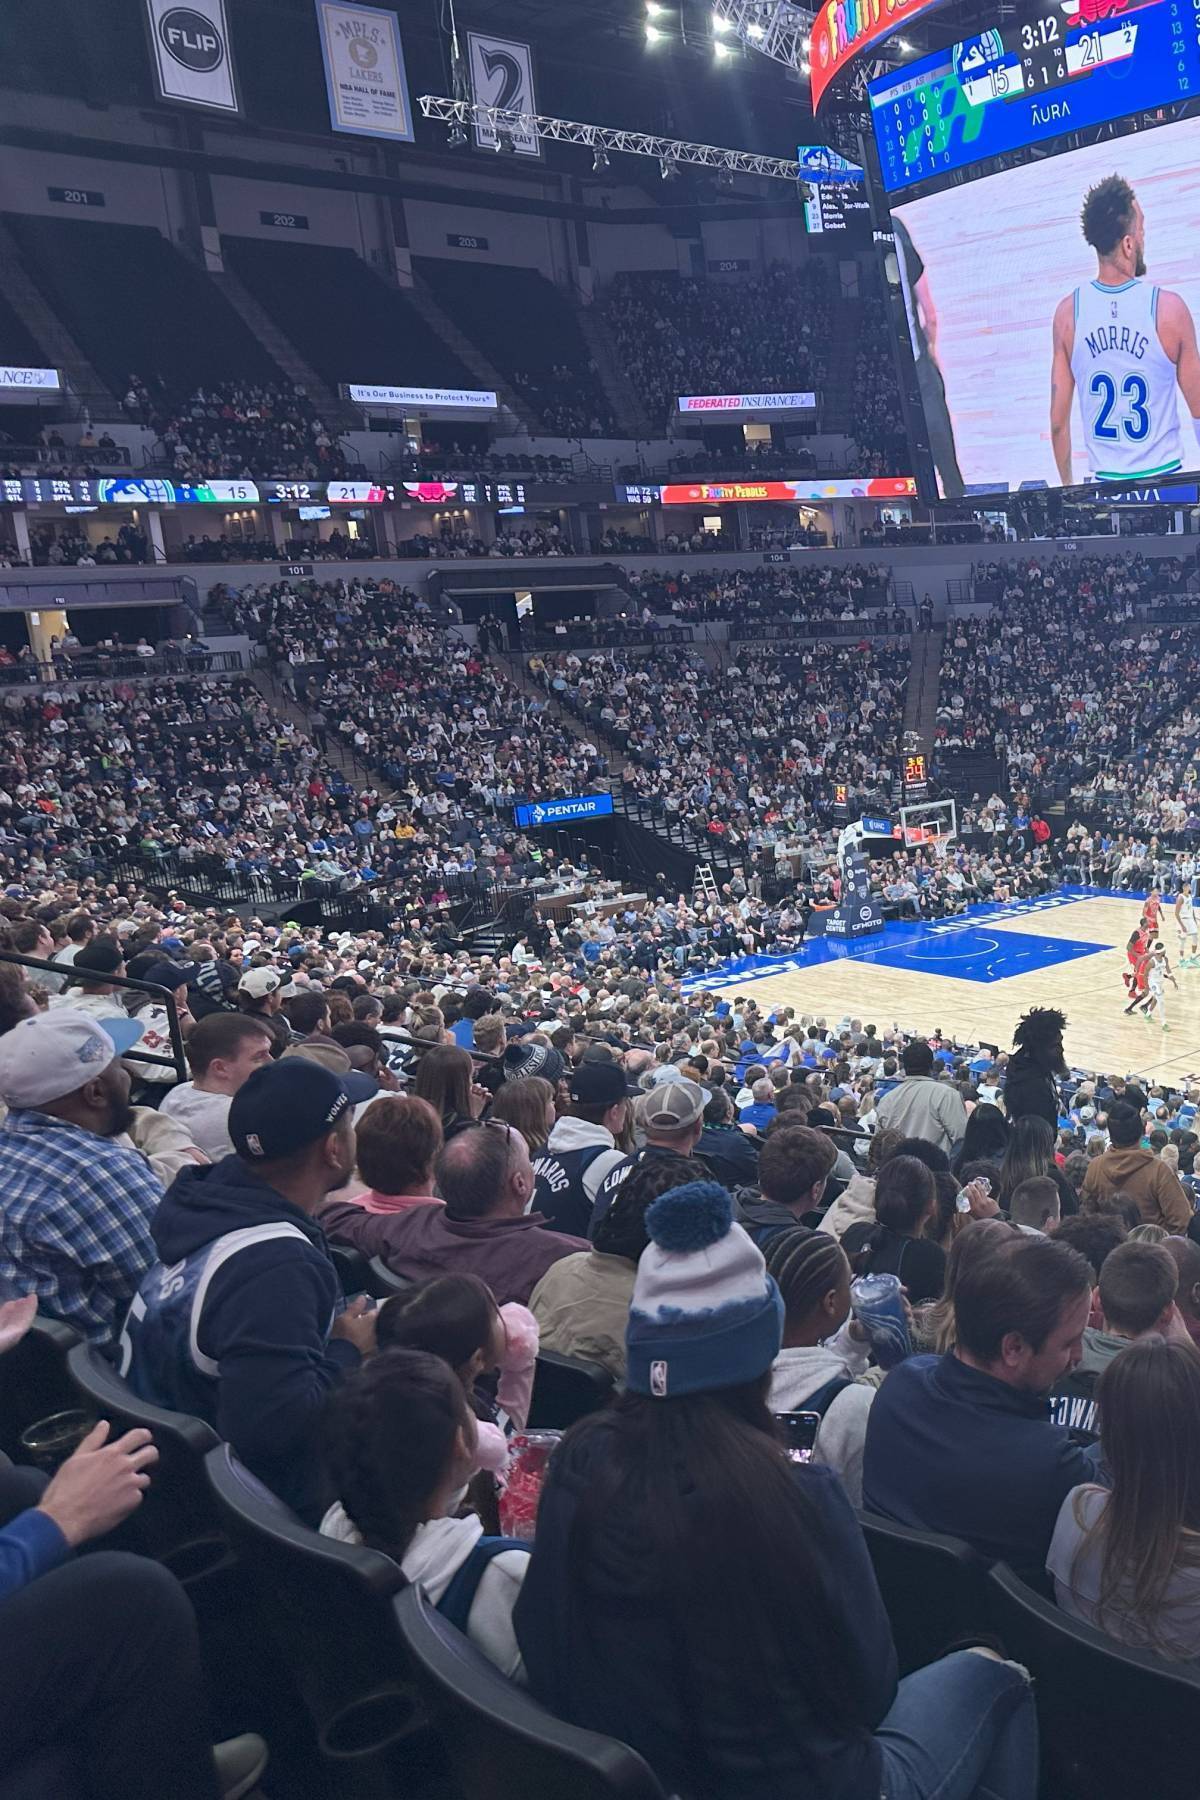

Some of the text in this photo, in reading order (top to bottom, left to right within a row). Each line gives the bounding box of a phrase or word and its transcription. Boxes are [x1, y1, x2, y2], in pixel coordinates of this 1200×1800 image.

[1171, 4, 1178, 16] 3
[339, 19, 379, 44] MPLS
[1021, 16, 1059, 50] 3:12
[1172, 22, 1182, 35] 13
[168, 28, 216, 51] FLIP
[1124, 31, 1131, 43] 2
[1078, 31, 1103, 67] 21
[1172, 40, 1185, 54] 25
[1178, 60, 1184, 72] 6
[349, 67, 384, 83] LAKERS
[479, 44, 524, 113] 2
[988, 64, 1009, 96] 15
[1027, 64, 1064, 88] 6 1 6
[1179, 78, 1189, 90] 12
[894, 87, 939, 115] 0 0 0 0
[897, 103, 942, 131] 0 0 0 0
[900, 119, 944, 147] 0 0 0
[902, 141, 933, 162] 2 0
[905, 151, 950, 177] 4 0
[64, 190, 87, 203] 201
[273, 215, 296, 226] 202
[458, 237, 477, 248] 203
[720, 262, 737, 271] 204
[1084, 326, 1149, 359] MORRIS
[389, 391, 423, 399] Business
[688, 396, 798, 409] FEDERATED INSURANCE
[1089, 370, 1151, 442] 23
[228, 487, 247, 499] 15
[275, 484, 311, 499] 3:12
[340, 487, 356, 499] 21
[626, 486, 640, 495] MIA
[702, 486, 767, 498] FRUITY PEBBLES
[627, 495, 640, 503] WAS
[288, 566, 304, 574] 101
[906, 765, 924, 781] 24
[548, 802, 596, 816] PENTAIR
[934, 892, 1096, 934] MINNESOTA
[852, 919, 881, 930] CFMOTO
[681, 959, 800, 993] etway
[325, 1093, 348, 1124] WOLVES
